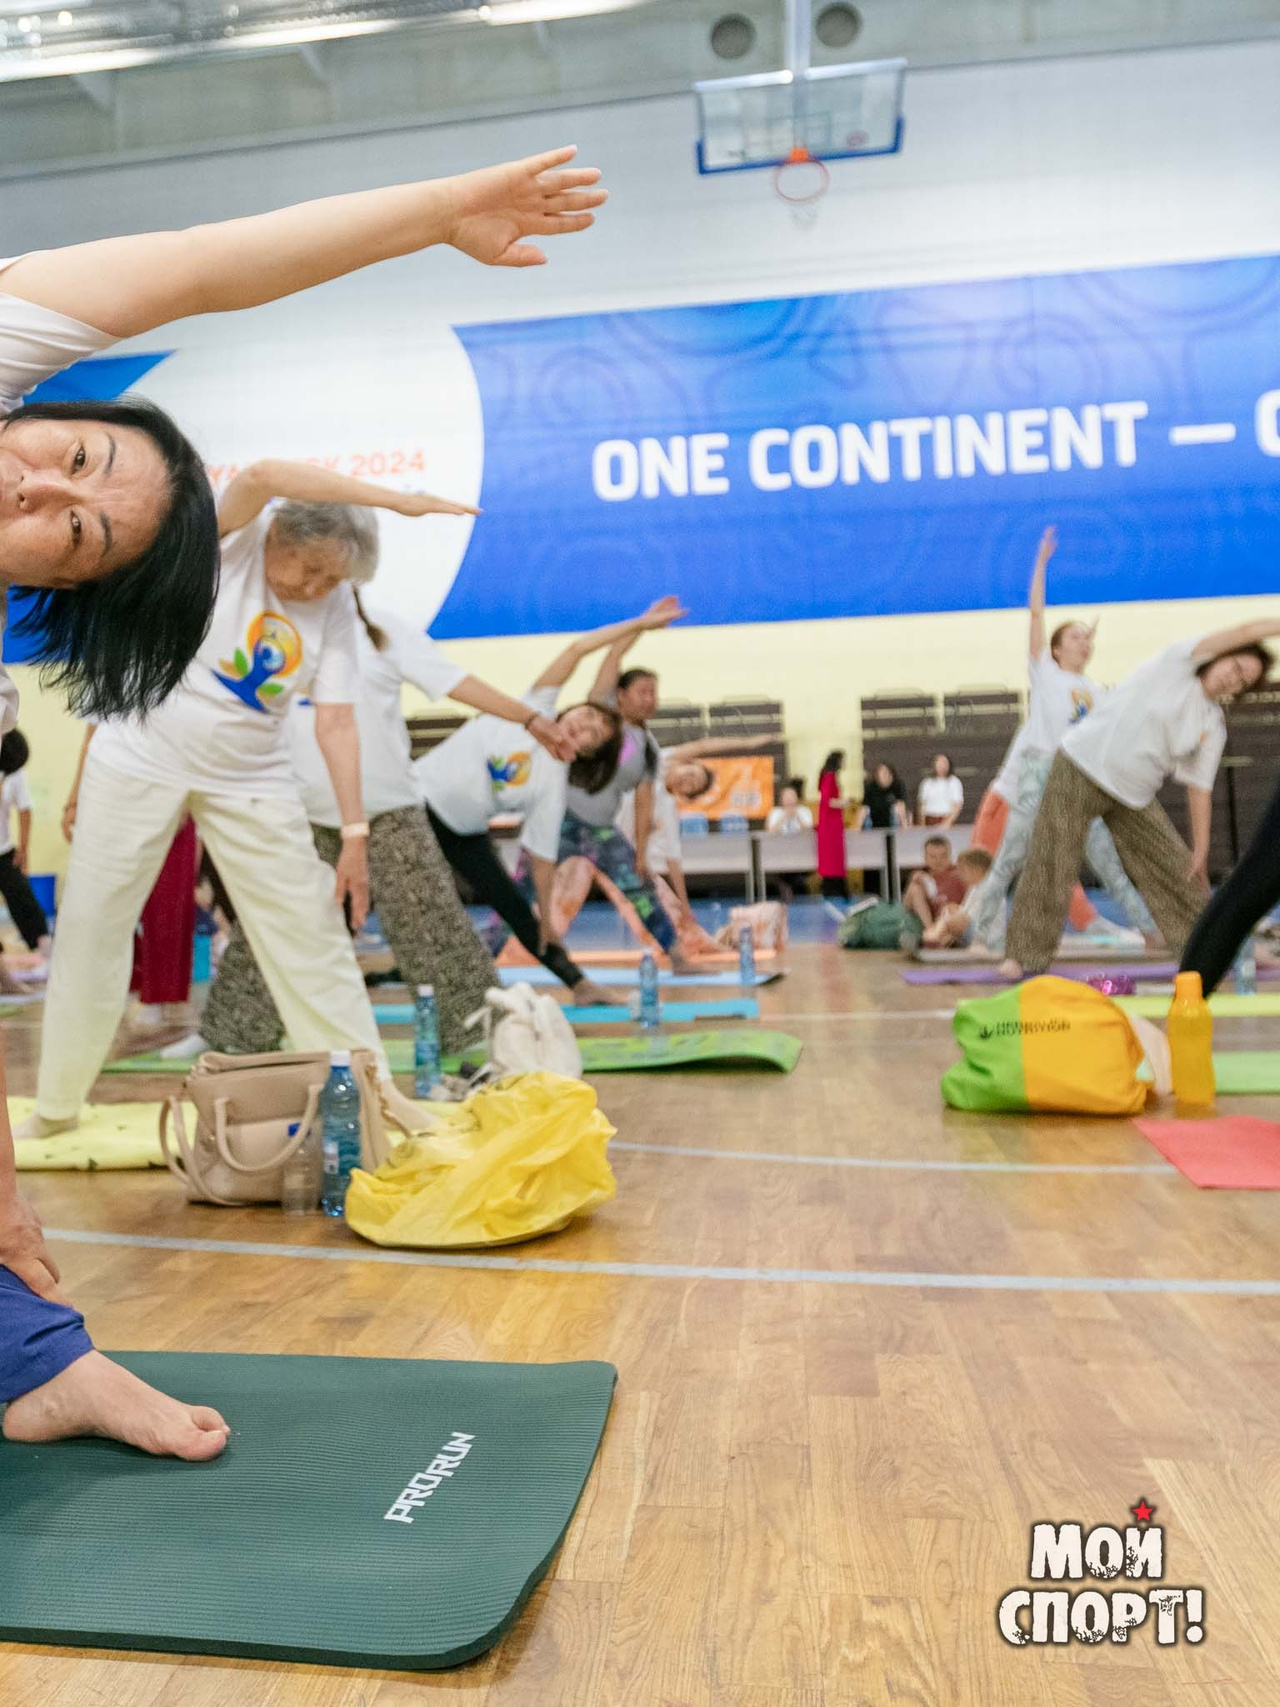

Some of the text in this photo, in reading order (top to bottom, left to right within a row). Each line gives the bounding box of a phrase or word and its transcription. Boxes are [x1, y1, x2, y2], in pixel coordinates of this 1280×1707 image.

[349, 447, 425, 478] 2024
[592, 432, 730, 502] ONE
[748, 400, 1149, 492] CONTINENT
[383, 1431, 477, 1524] PRORUN
